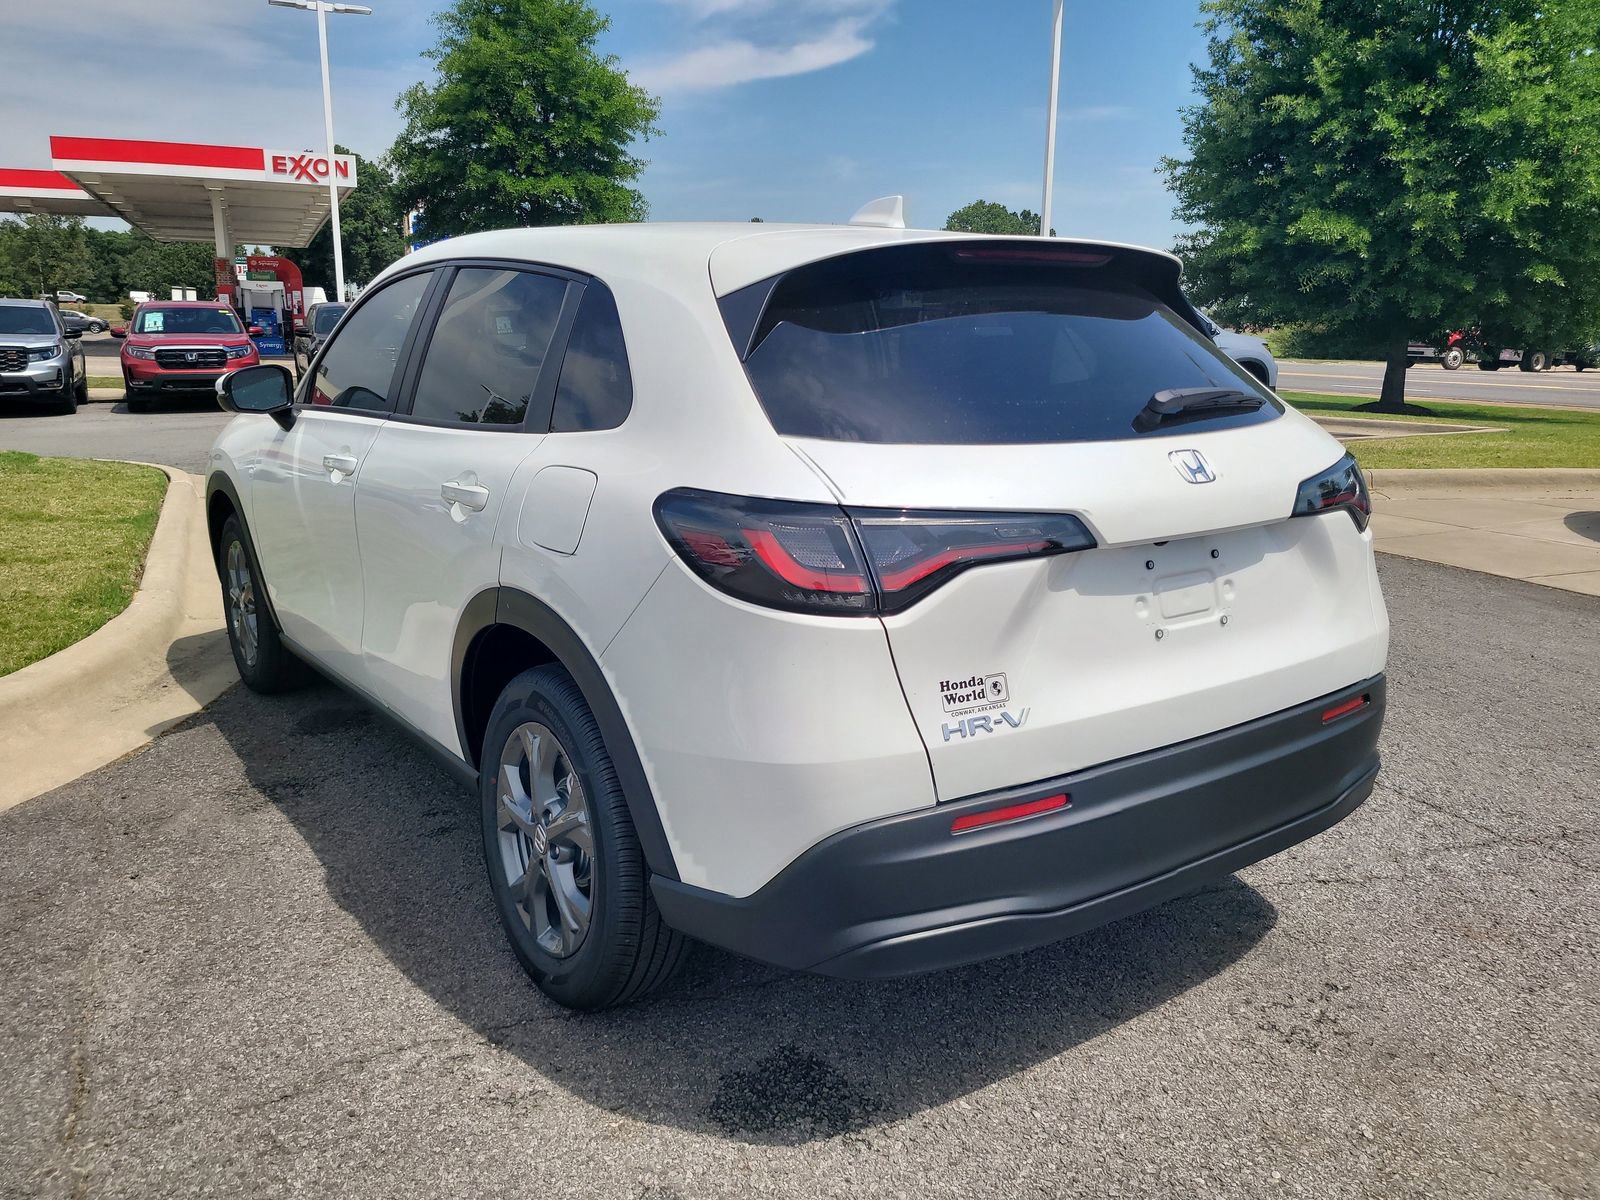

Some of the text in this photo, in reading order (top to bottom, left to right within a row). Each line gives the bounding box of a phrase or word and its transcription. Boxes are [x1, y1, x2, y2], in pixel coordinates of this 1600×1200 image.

[272, 155, 348, 183] EXXON
[939, 676, 984, 692] Honda
[944, 688, 986, 705] World
[950, 703, 1007, 717] CONWAY, ARKANSAS
[941, 708, 1031, 742] HR-V
